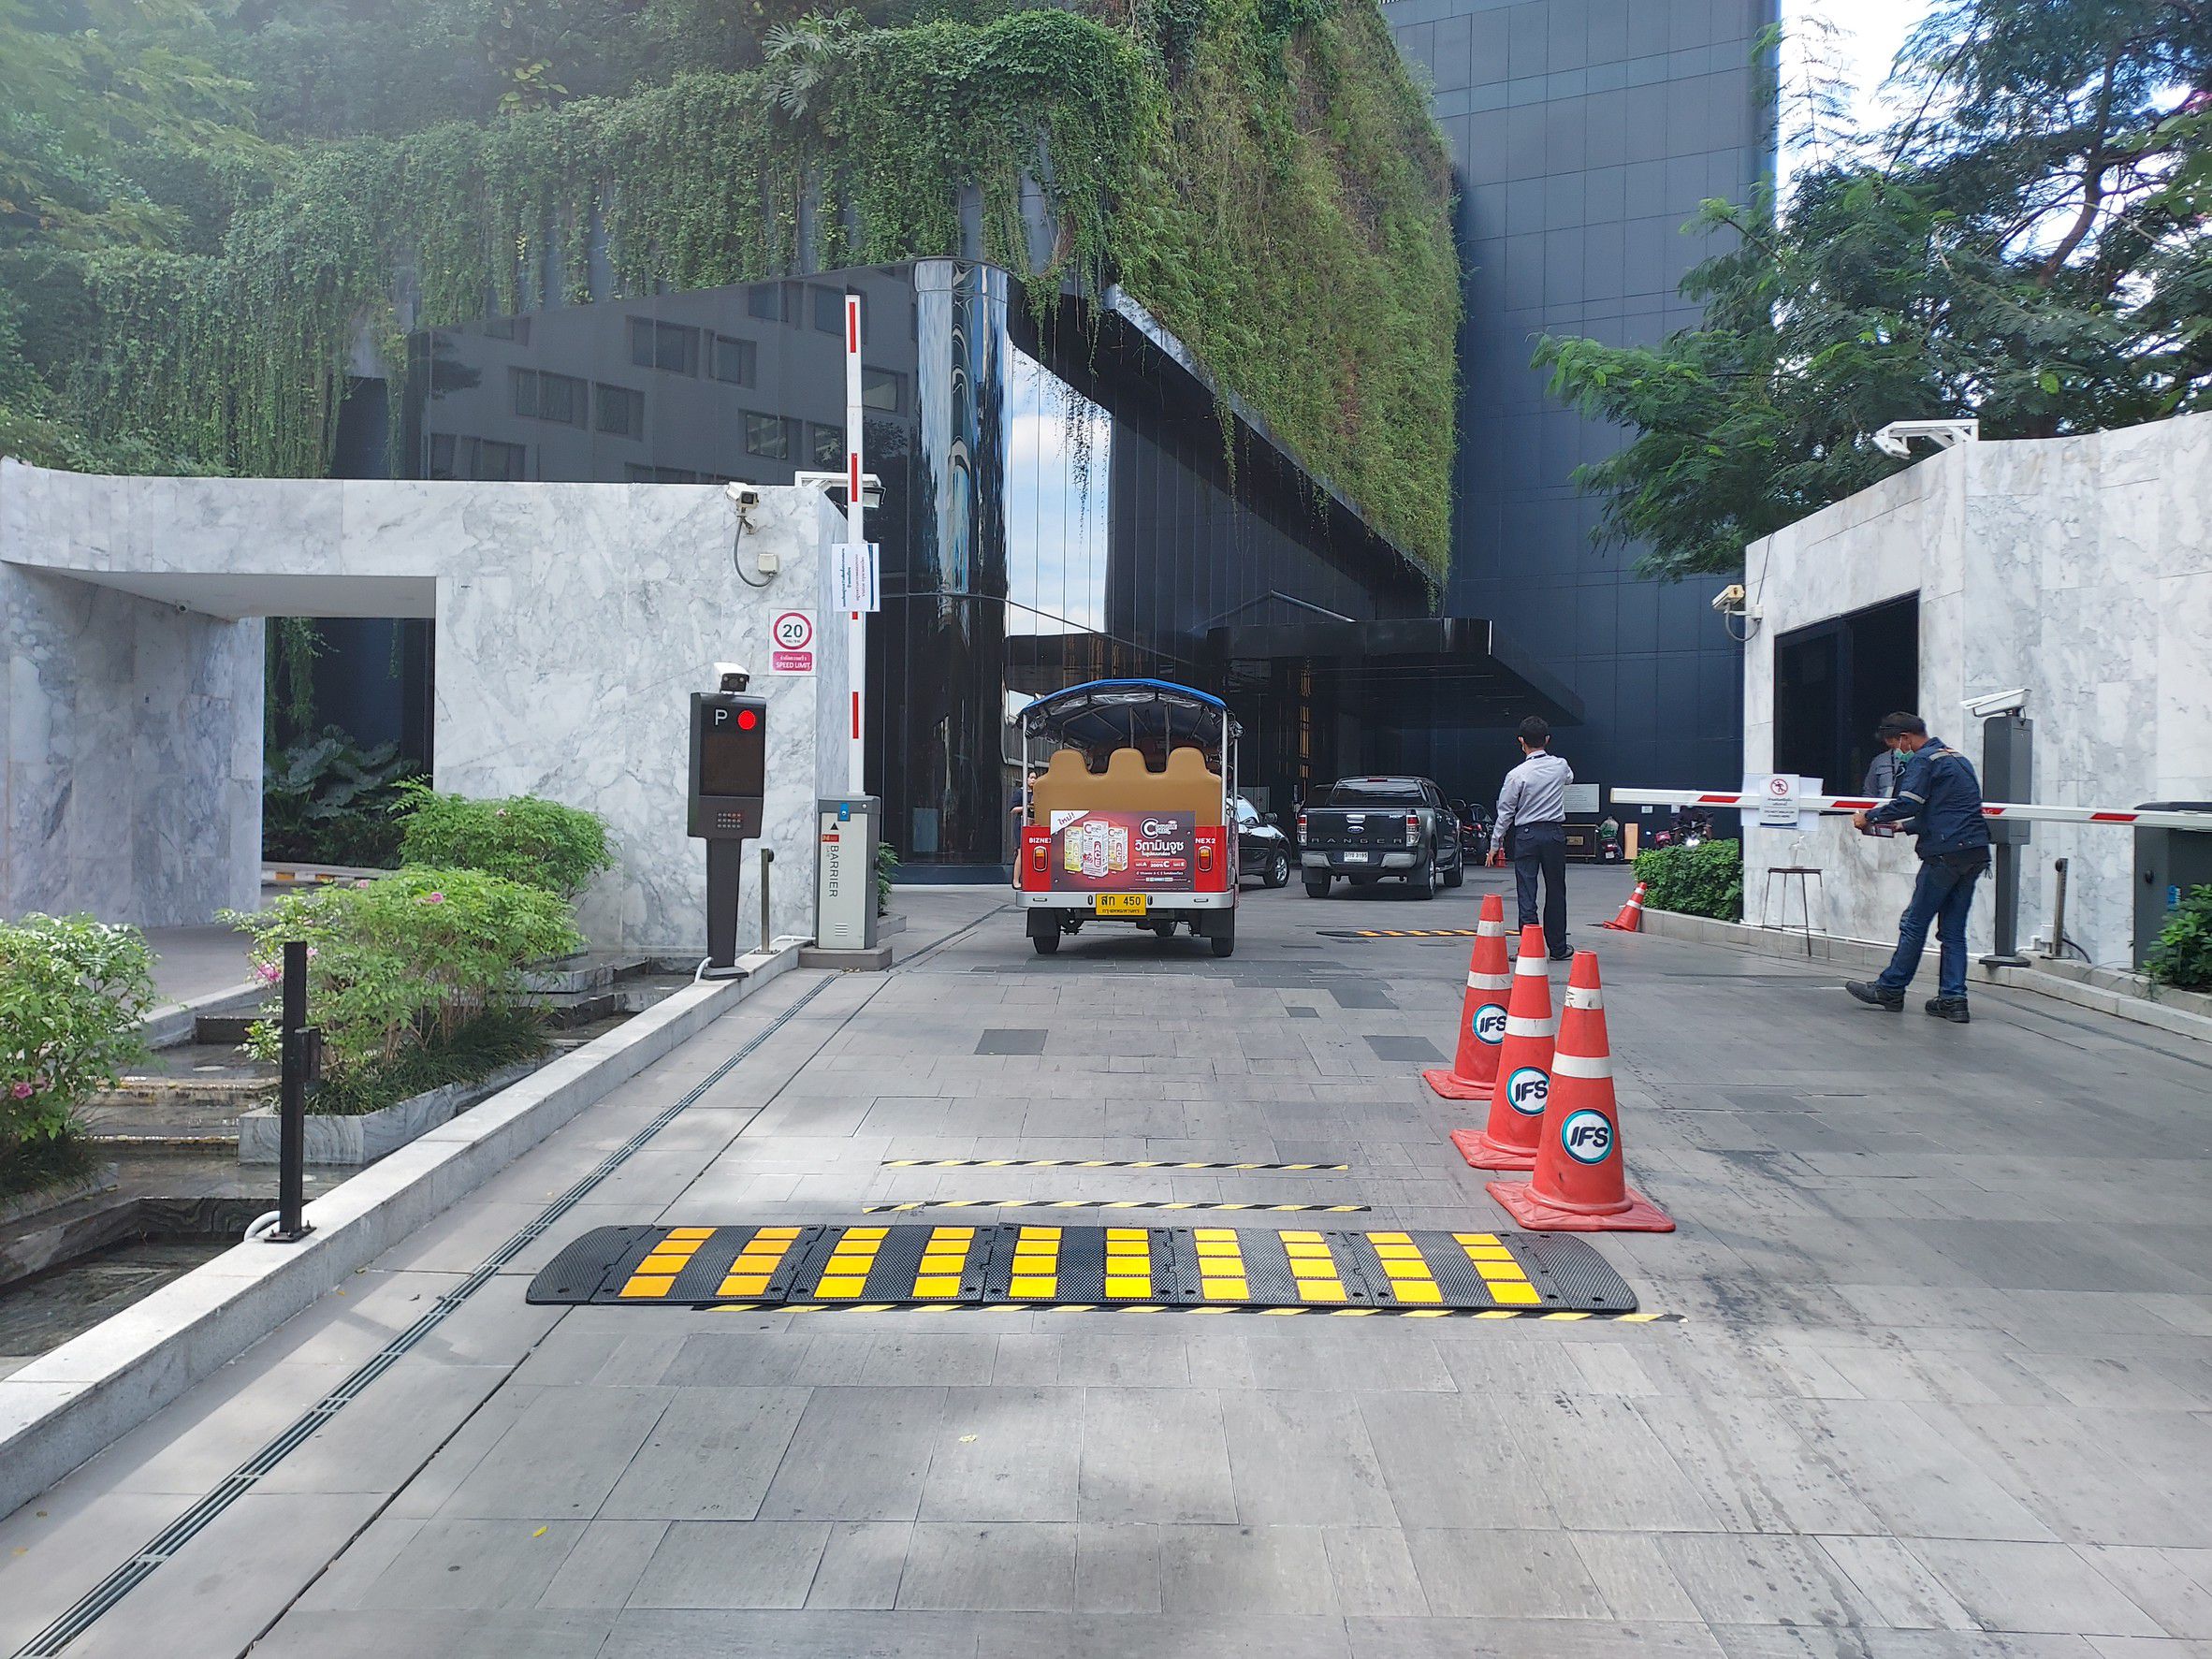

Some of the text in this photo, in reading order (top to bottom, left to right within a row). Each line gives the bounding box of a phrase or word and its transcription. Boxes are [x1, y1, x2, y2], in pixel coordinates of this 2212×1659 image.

[782, 623, 803, 638] 20
[714, 708, 728, 726] P
[829, 845, 839, 897] BARRIER
[1123, 895, 1142, 906] 450
[1479, 1015, 1506, 1033] IFS
[1515, 1080, 1548, 1102] IFS
[1570, 1126, 1608, 1148] IFS
